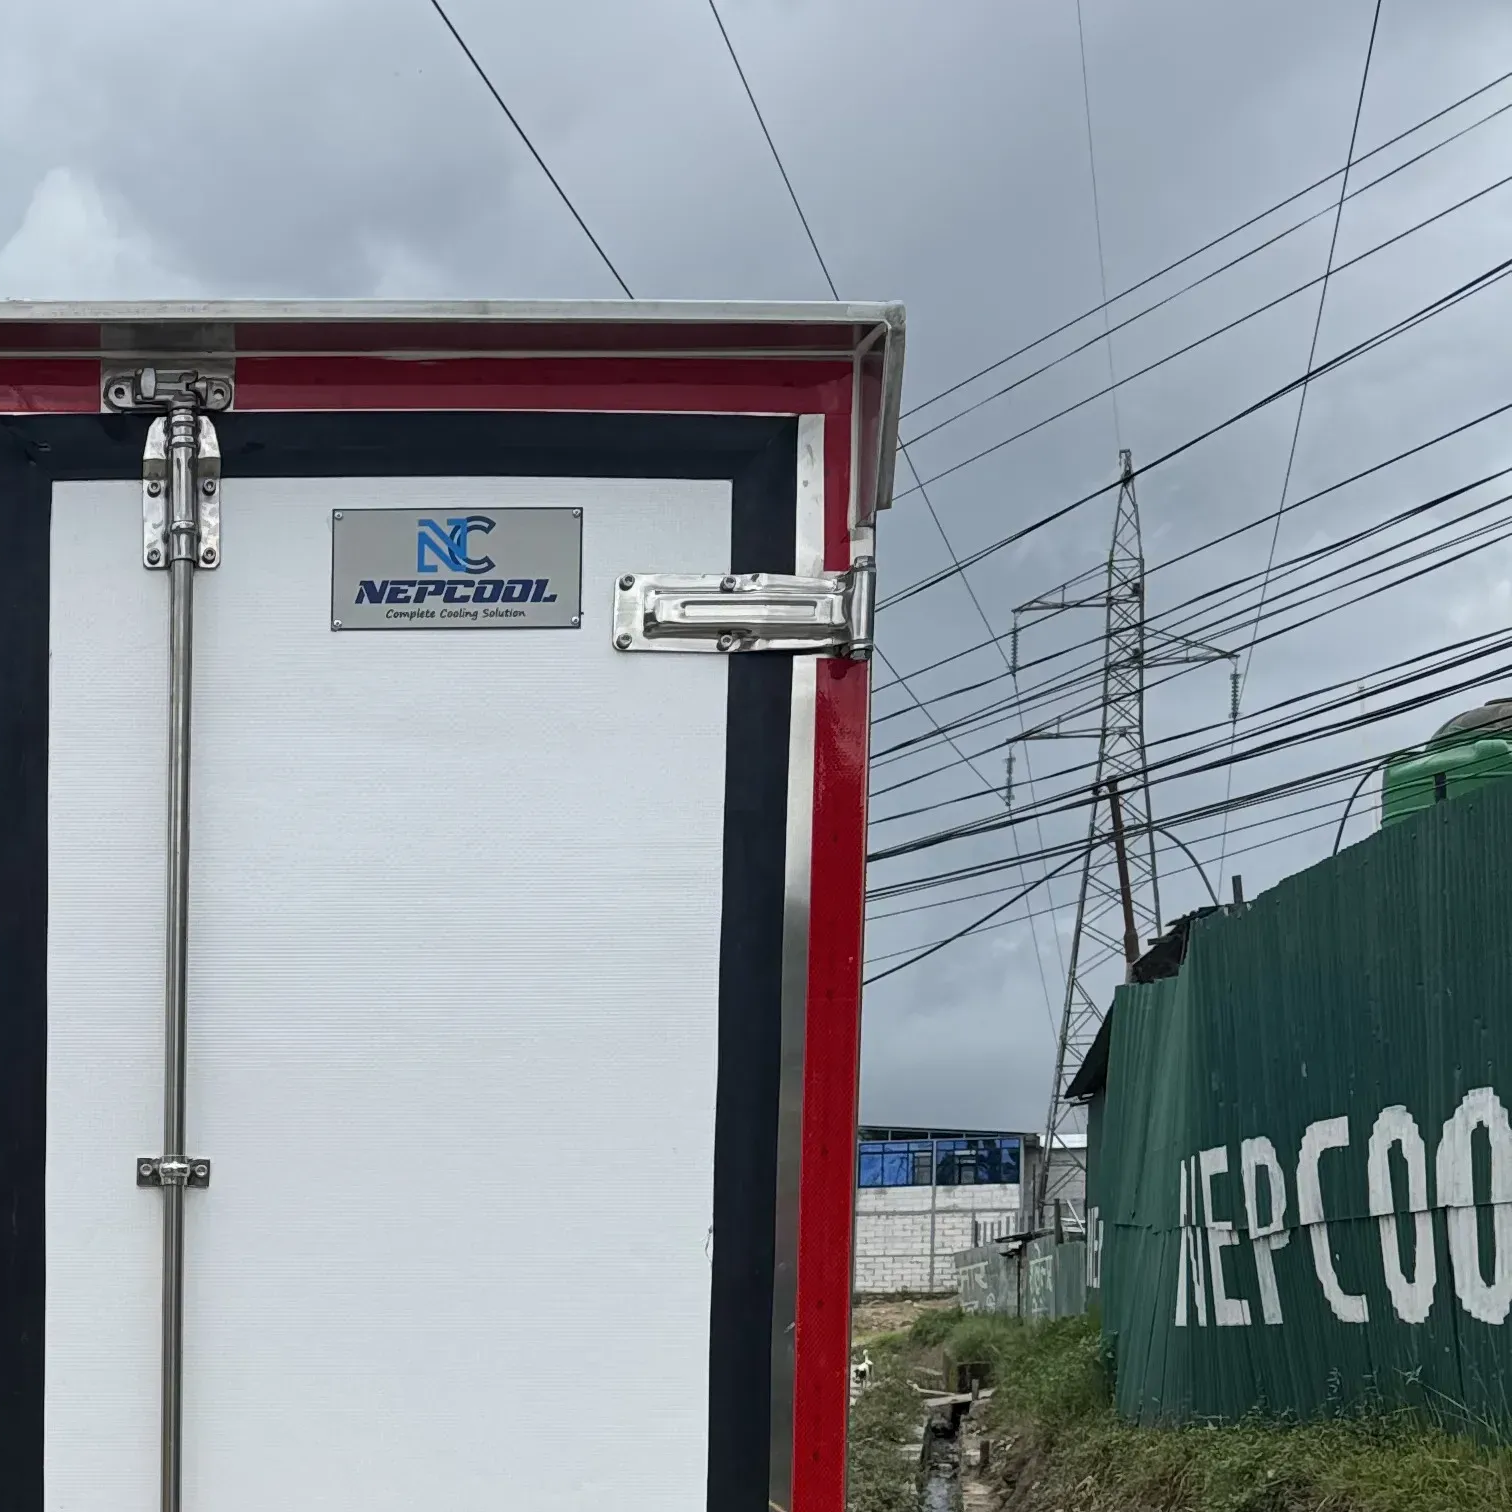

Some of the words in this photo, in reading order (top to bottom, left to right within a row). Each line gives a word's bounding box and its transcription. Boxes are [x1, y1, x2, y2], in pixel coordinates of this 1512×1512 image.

[355, 579, 557, 604] NEPCOOL
[386, 608, 436, 621] Complete
[440, 607, 478, 621] Cooling
[483, 608, 525, 618] Solution
